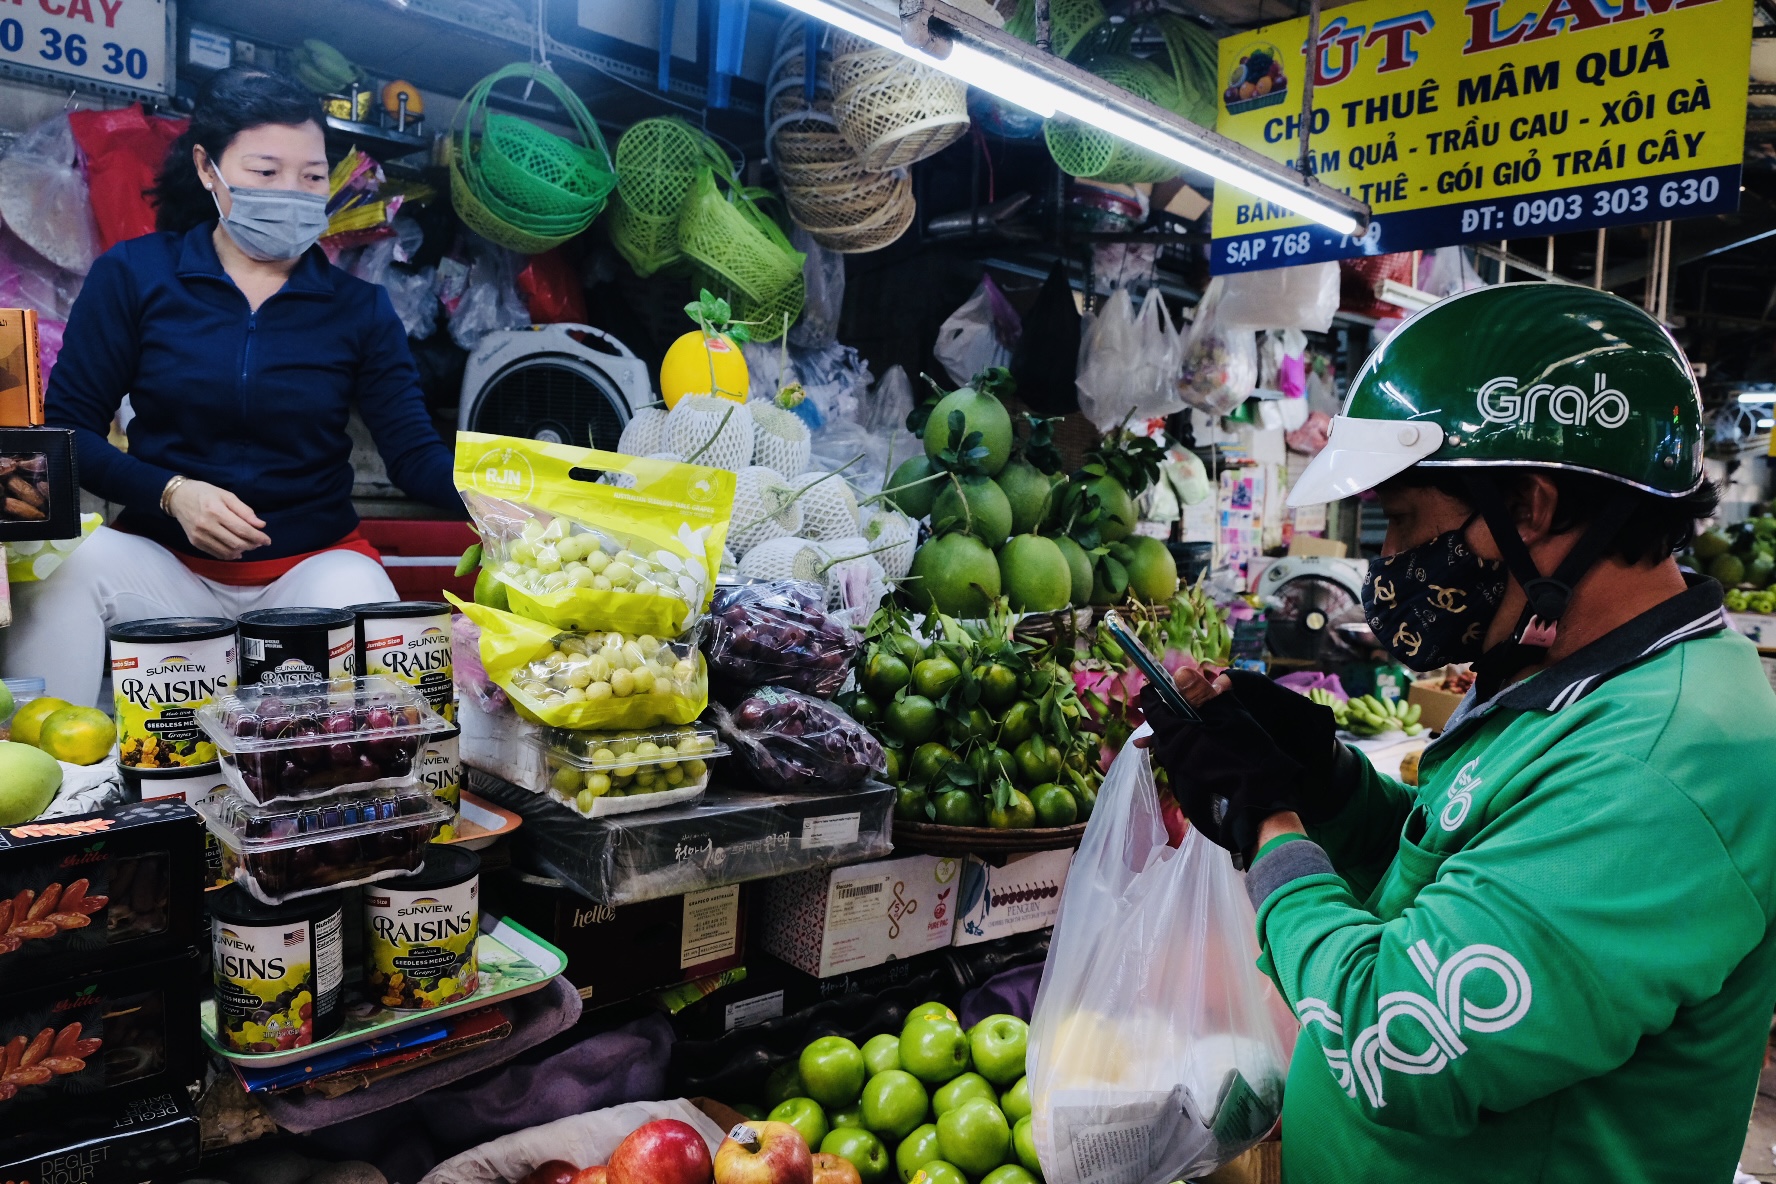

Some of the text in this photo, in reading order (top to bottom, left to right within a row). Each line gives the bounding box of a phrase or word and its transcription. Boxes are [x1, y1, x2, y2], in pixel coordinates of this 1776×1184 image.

[39, 27, 87, 66] 36
[102, 42, 147, 80] 30
[1264, 28, 1669, 144] CHO THUÊ MÂM QUẢ
[1348, 131, 1398, 169] QUẢ
[1426, 115, 1500, 155] TRẦU
[1510, 109, 1568, 141] CAU
[1600, 90, 1655, 127] XÔI
[1667, 79, 1711, 116] GÀ
[1361, 173, 1409, 204] THÊ
[1437, 161, 1484, 194] GÓI
[1493, 149, 1541, 186] GIỎ
[1552, 139, 1626, 177] TRÁI
[1637, 129, 1706, 165] CÂY
[1226, 239, 1266, 266] SẠP
[1272, 231, 1311, 257] 768
[1461, 206, 1504, 233] ĐT:
[1512, 194, 1583, 226] 0903
[1592, 185, 1649, 216] 303
[1659, 176, 1720, 208] 630
[1476, 373, 1630, 430] Grab
[485, 467, 521, 487] RJN
[366, 641, 386, 649] Jumbo
[146, 664, 206, 677] SUNVIEW
[275, 664, 315, 673] SUNVIEW
[146, 721, 182, 729] SEEDLESS
[397, 904, 453, 917] SUNVIEW
[894, 903, 900, 913] 5
[1007, 901, 1040, 917] PENGUIN
[372, 910, 472, 949] RAISINS
[428, 954, 454, 964] MEDLEY
[112, 1105, 180, 1129] DEGLET
[41, 1145, 111, 1176] DEGLET
